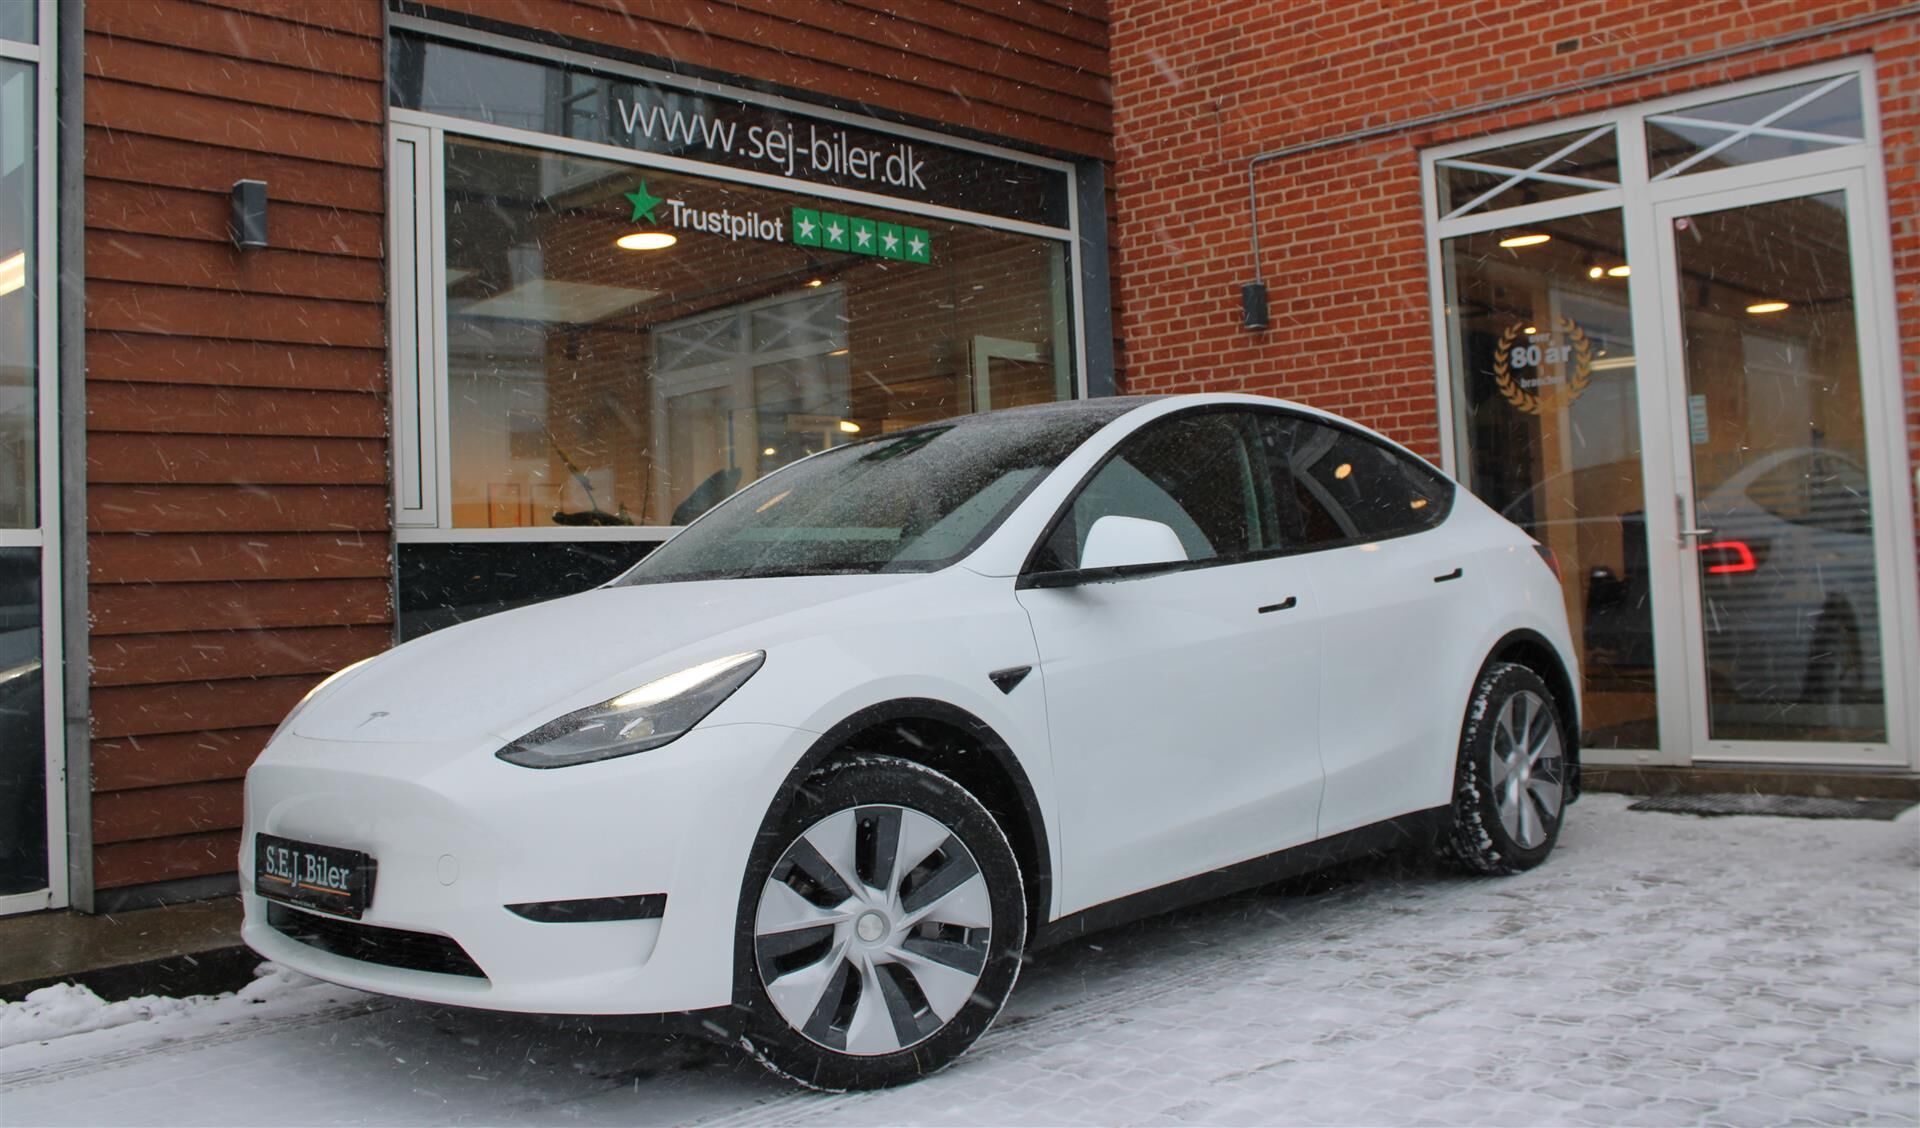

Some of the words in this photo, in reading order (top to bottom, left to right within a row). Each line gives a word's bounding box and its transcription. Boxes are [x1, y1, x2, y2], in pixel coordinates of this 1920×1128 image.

[617, 98, 926, 190] www.sej-biler.dk
[667, 199, 784, 242] Trustpilot
[1511, 345, 1540, 369] 80
[266, 845, 302, 888] S.E.J.
[304, 854, 350, 890] Biler
